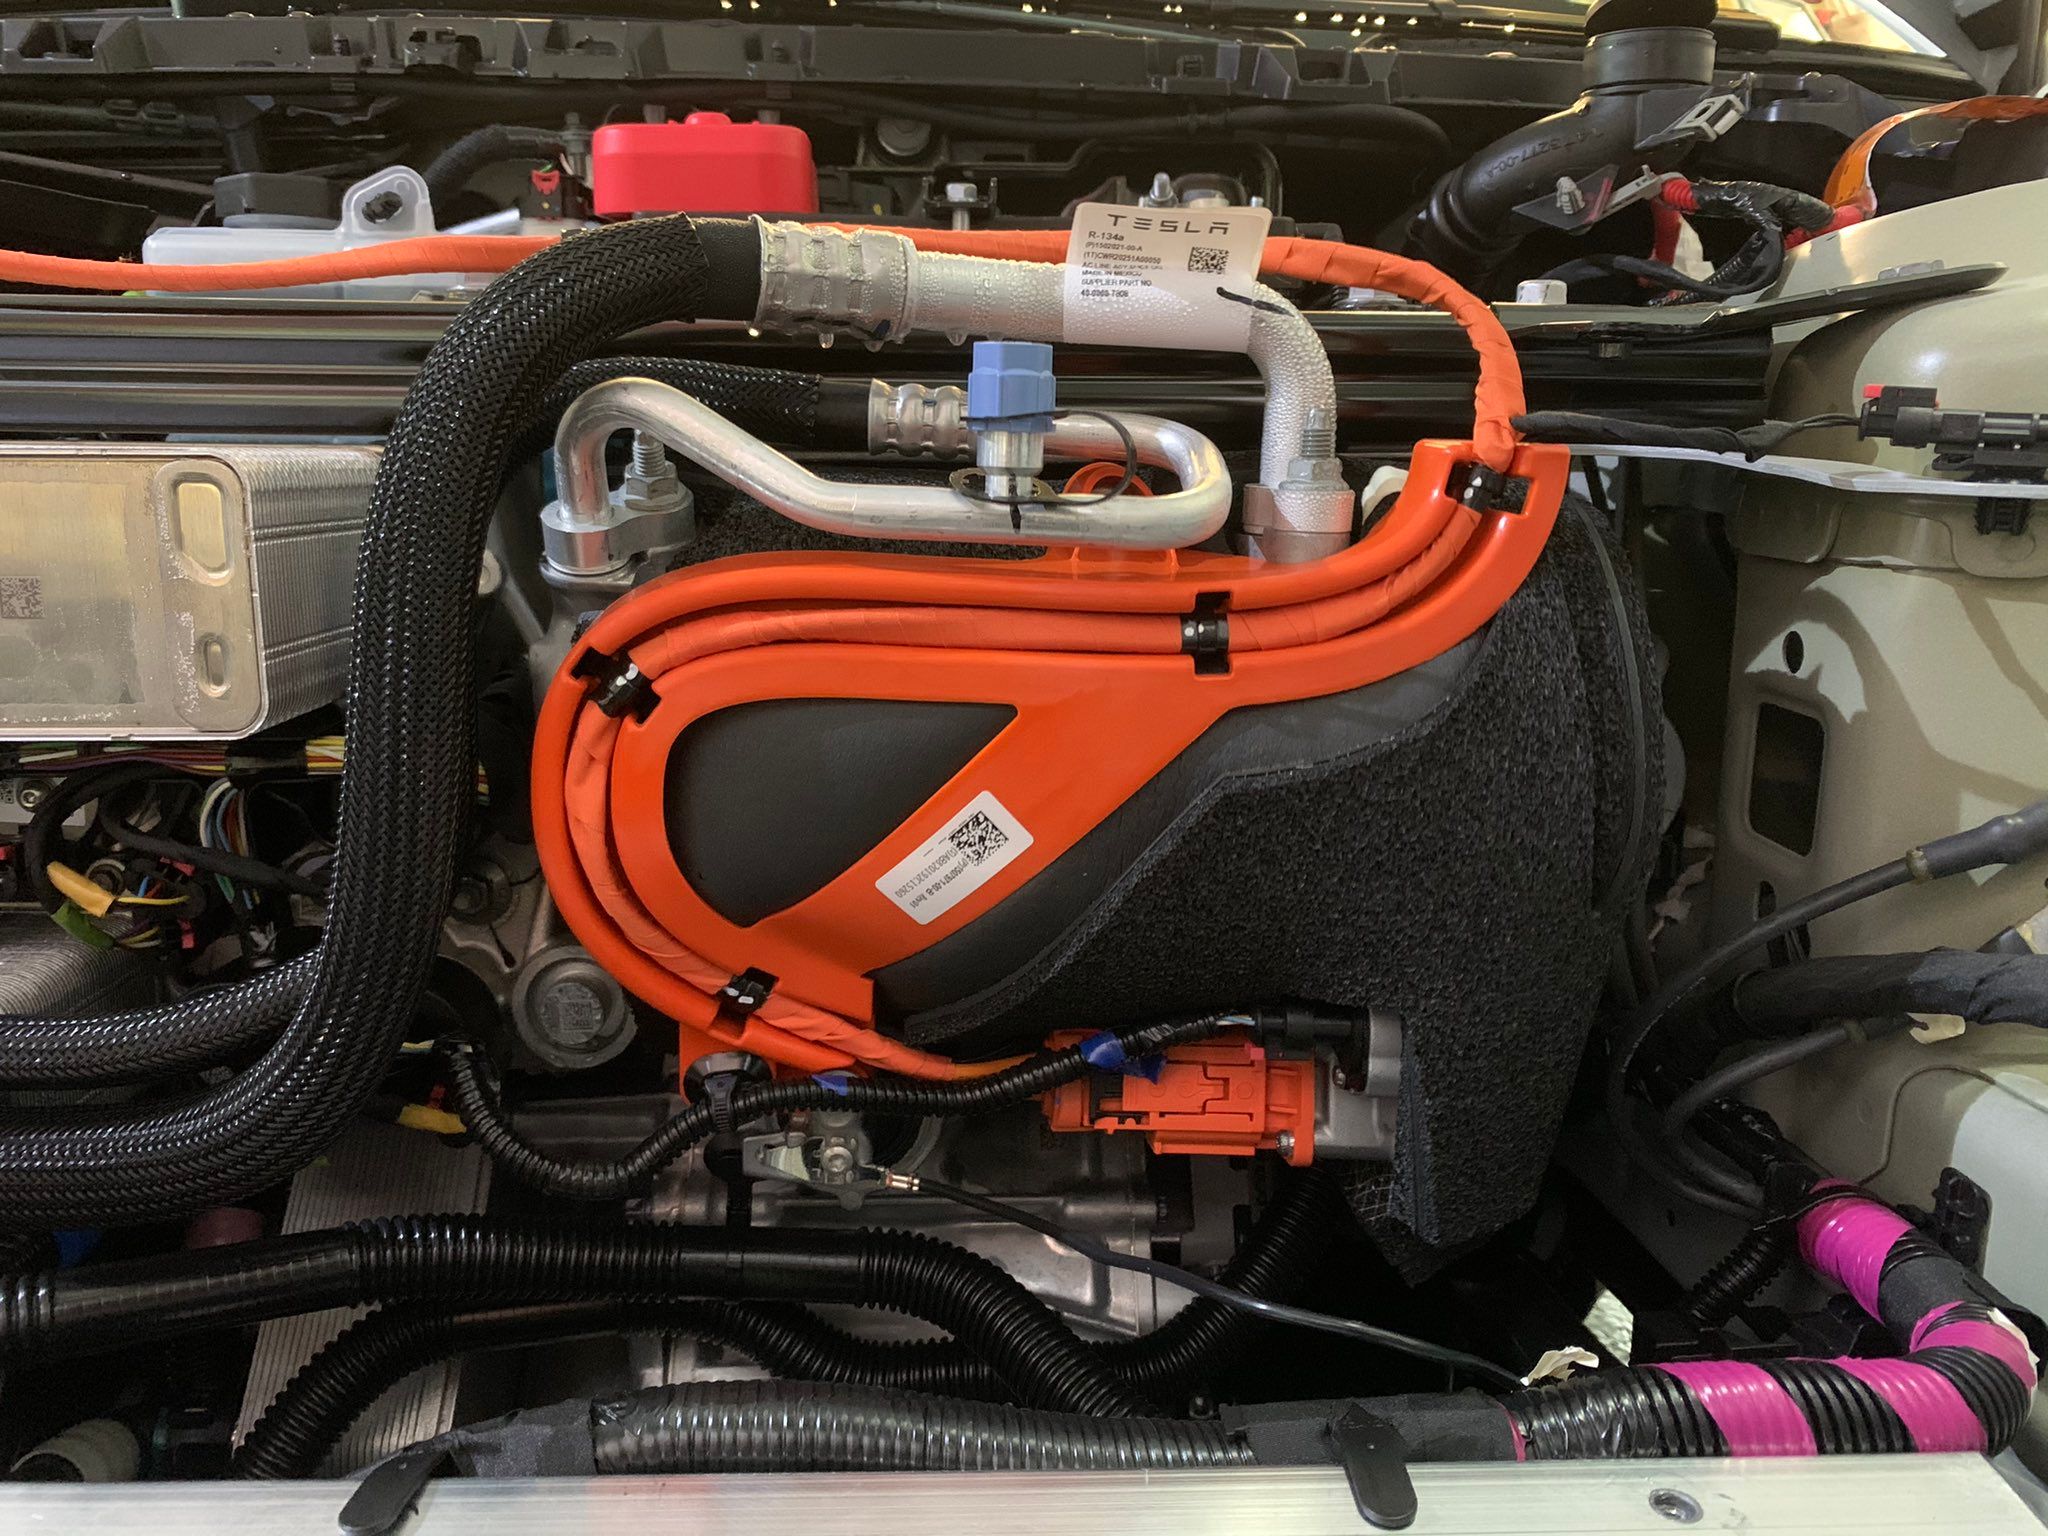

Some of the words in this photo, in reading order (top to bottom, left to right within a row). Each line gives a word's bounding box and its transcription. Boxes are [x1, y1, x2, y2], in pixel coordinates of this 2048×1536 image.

[1107, 213, 1230, 235] TESLA
[1088, 230, 1125, 241] R-134a
[1081, 278, 1118, 286] SUPPLIER
